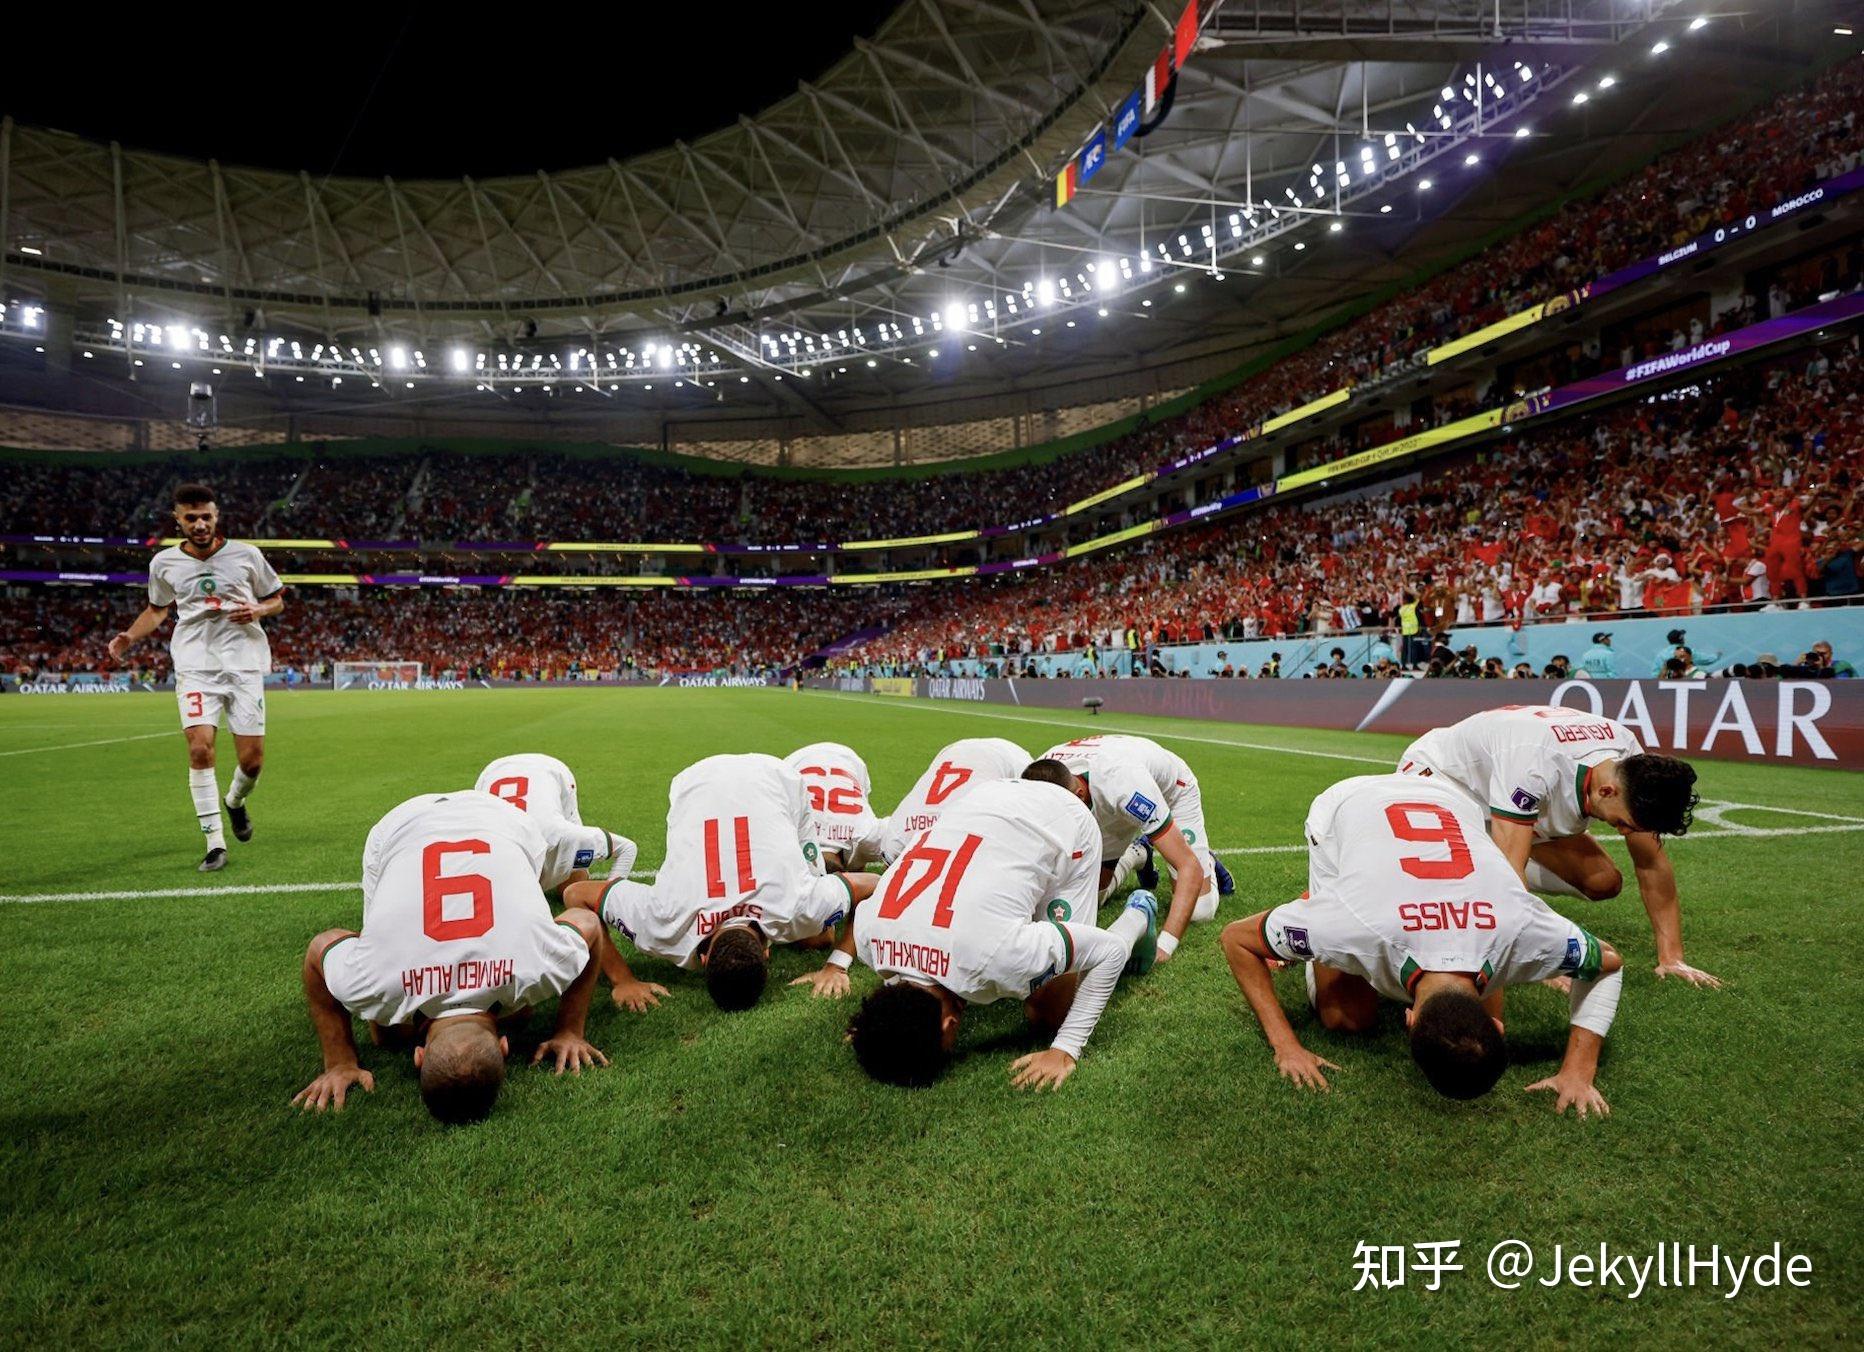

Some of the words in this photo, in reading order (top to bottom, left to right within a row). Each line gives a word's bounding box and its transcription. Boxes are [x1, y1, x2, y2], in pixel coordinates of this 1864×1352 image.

[1658, 242, 1698, 265] BELGIUM
[1714, 228, 1725, 242] 0
[1745, 215, 1757, 230] 0
[1772, 188, 1824, 217] MOROCCO
[1625, 340, 1730, 381] #FIFAWorldCup
[19, 683, 67, 694] QATAR
[71, 682, 130, 694] AIRWAYS
[679, 678, 716, 687] QATAR
[721, 677, 767, 687] AIRWAYS
[929, 678, 950, 699] QATAR
[952, 678, 986, 700] AIRWAYS
[186, 691, 203, 717] 3
[925, 761, 973, 805] 4
[704, 816, 757, 898] 11
[877, 830, 984, 928] 14
[1398, 901, 1496, 932] SAISS
[402, 965, 452, 996] ALLAH
[457, 959, 513, 990] HAMED
